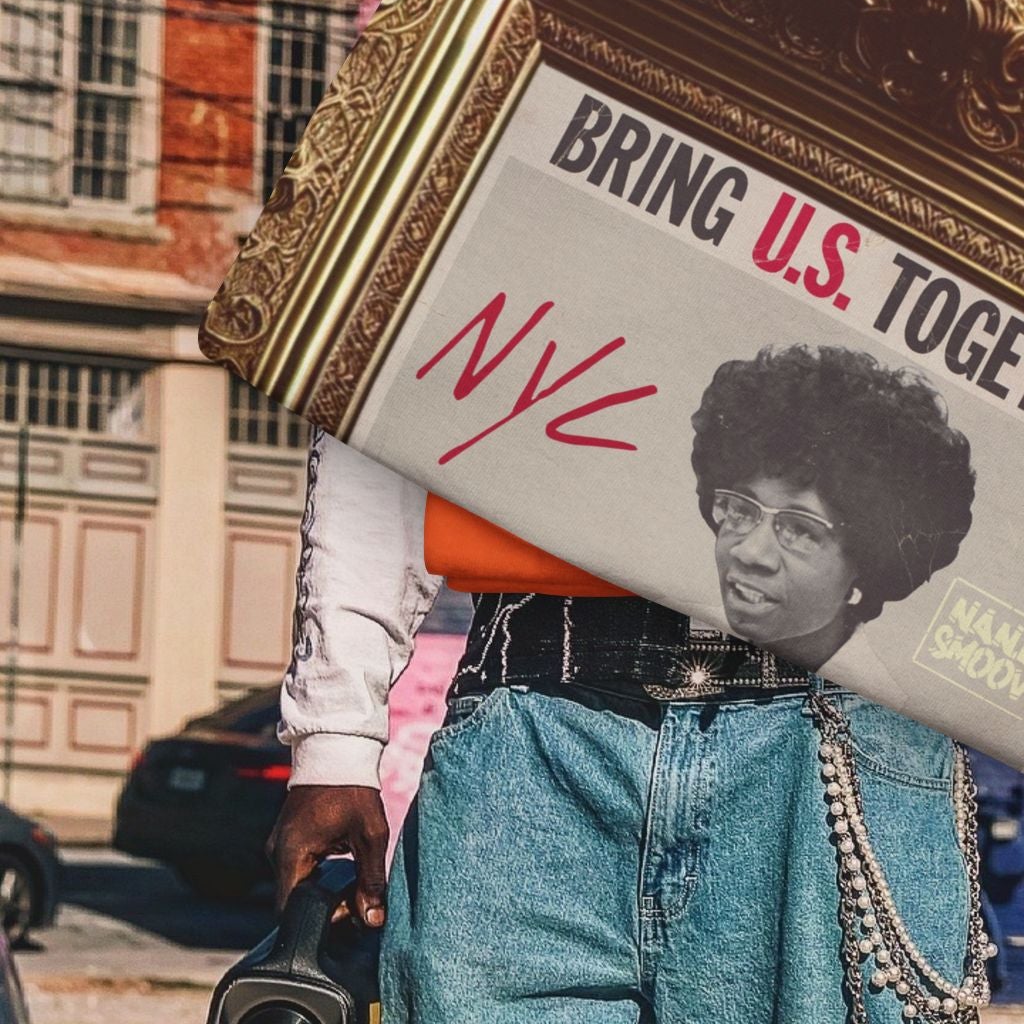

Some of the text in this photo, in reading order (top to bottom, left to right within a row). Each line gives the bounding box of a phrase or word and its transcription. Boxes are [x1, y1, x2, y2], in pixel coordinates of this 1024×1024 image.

[549, 93, 749, 247] BRING
[751, 192, 861, 311] U.S.
[416, 292, 658, 465] NYC
